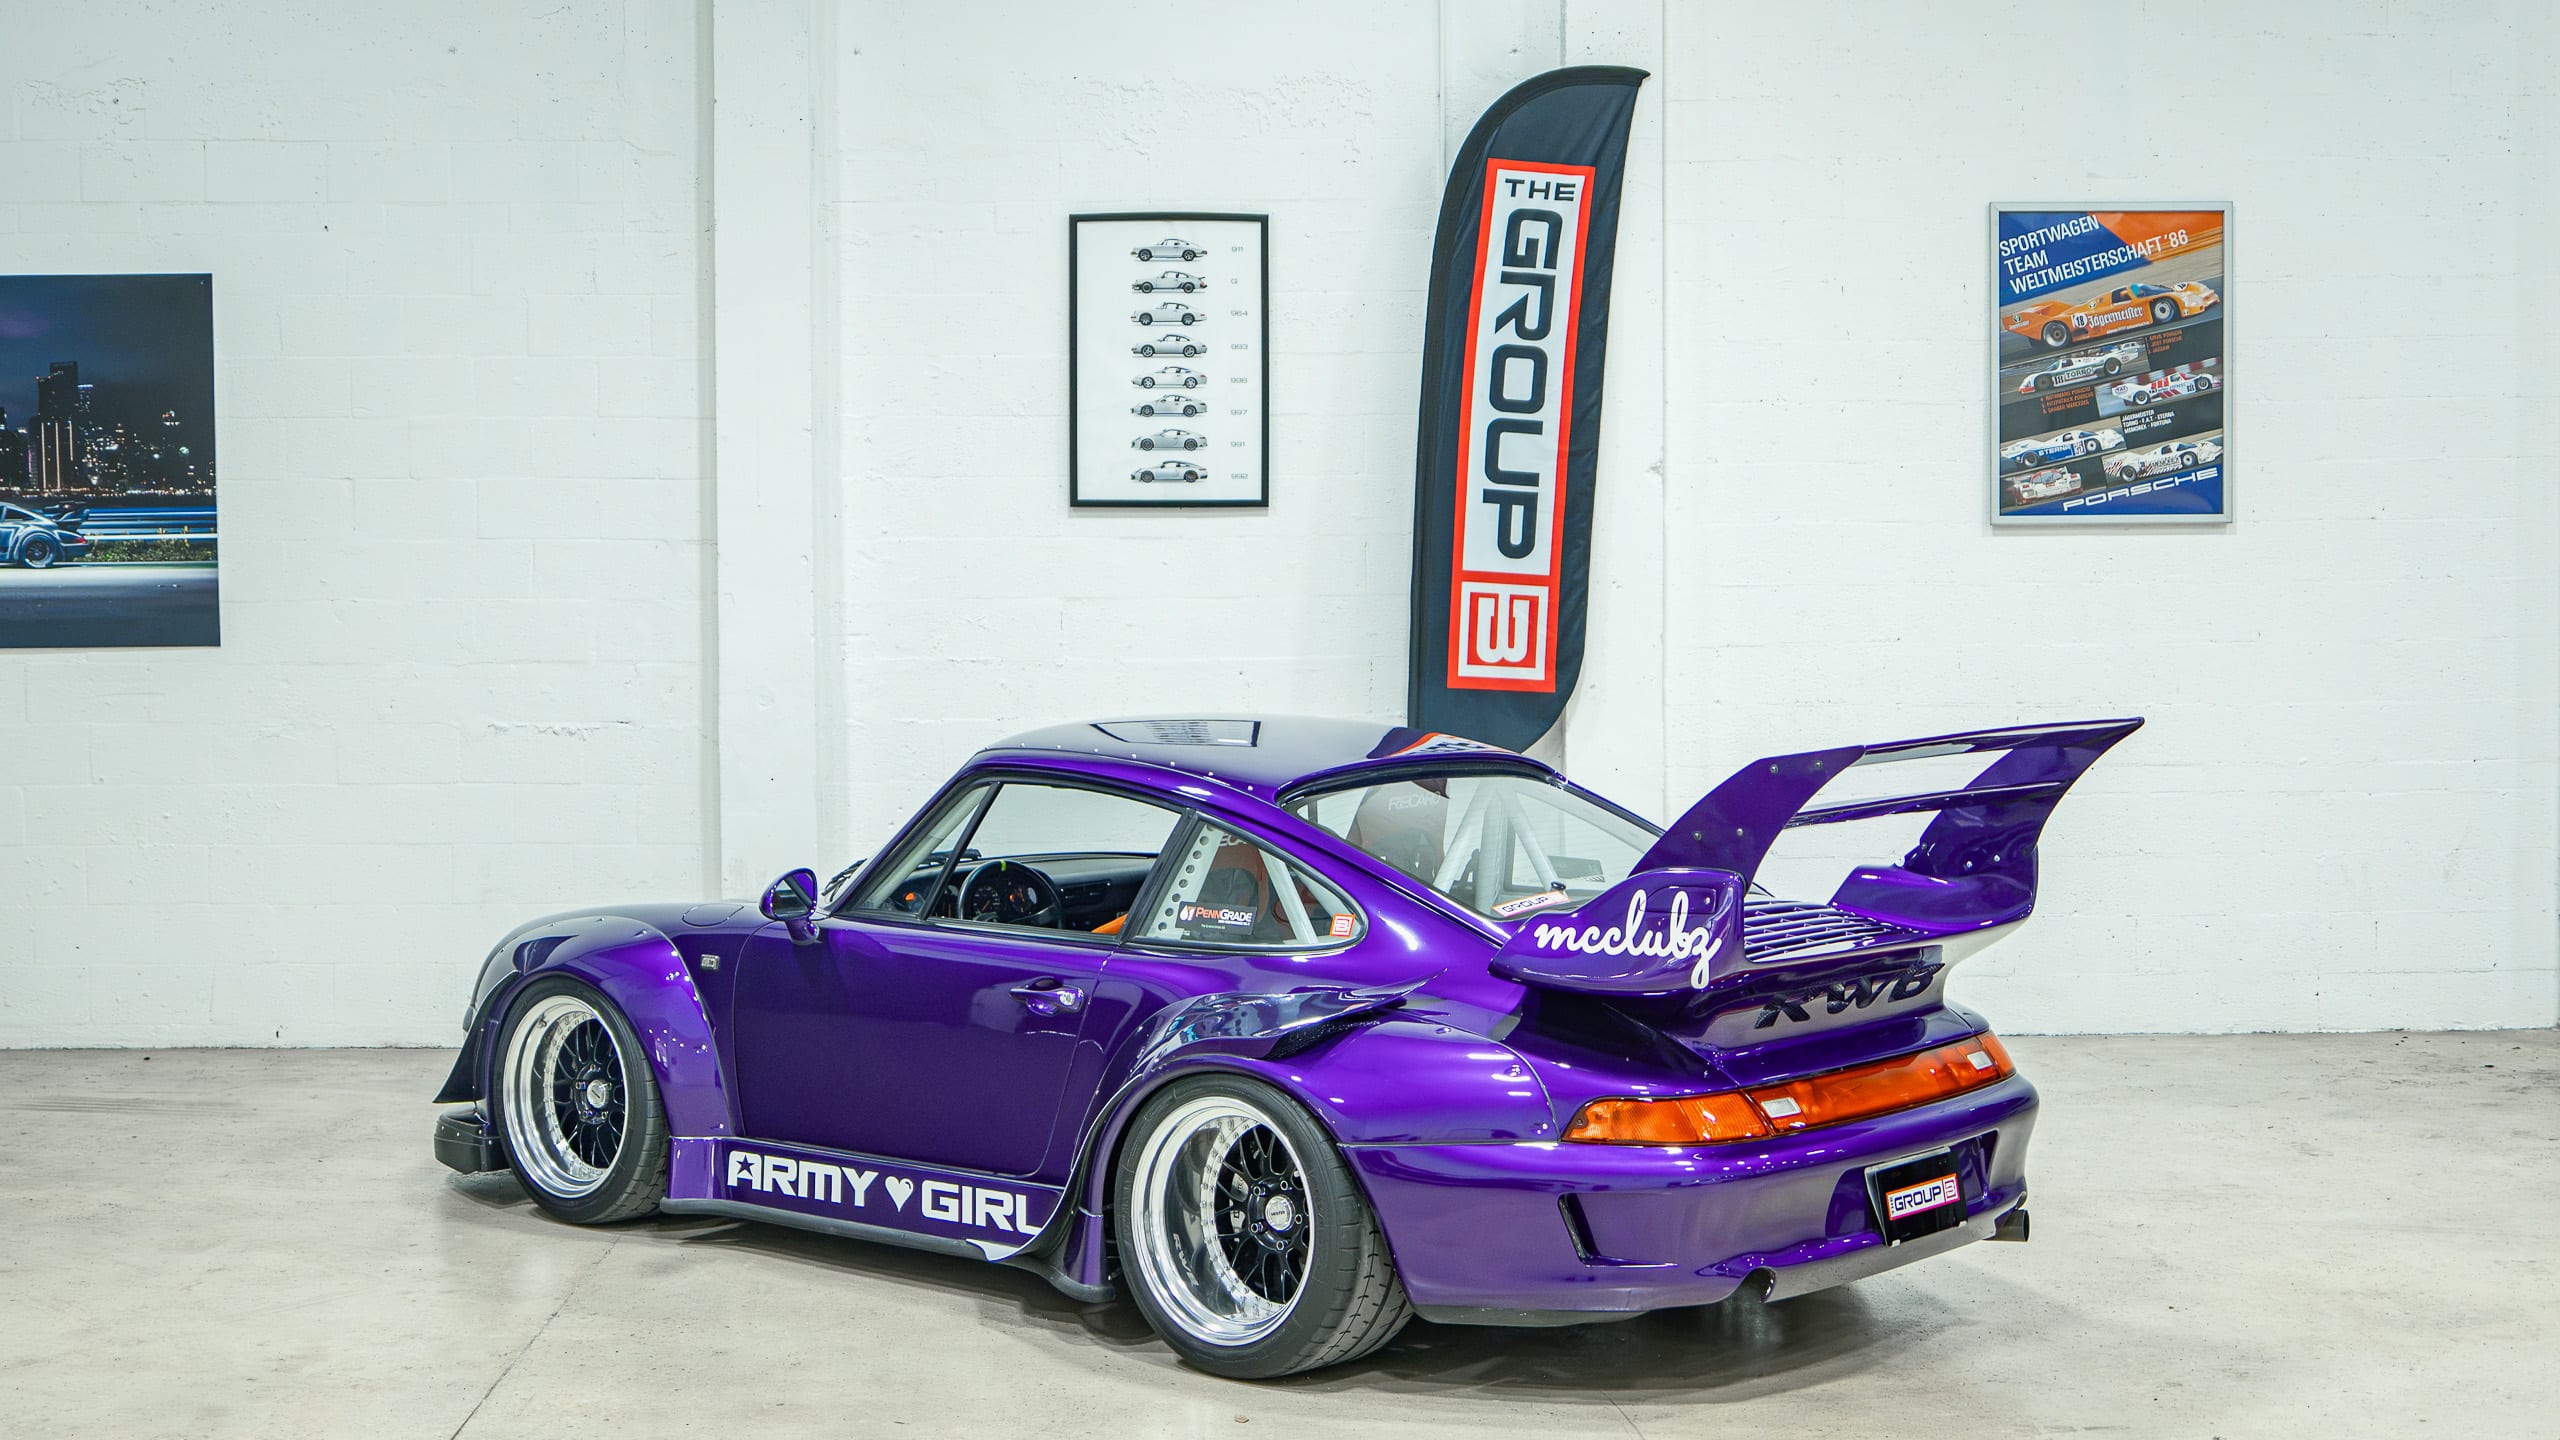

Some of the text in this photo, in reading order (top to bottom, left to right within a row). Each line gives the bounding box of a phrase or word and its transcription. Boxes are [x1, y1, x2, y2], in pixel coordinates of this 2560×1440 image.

[1504, 177, 1576, 202] THE
[2000, 214, 2100, 257] SPORTWAGEN
[2004, 249, 2049, 276] TEAM
[2010, 229, 2190, 294] WELTMEISTERSCHAFT '86
[1482, 208, 1564, 559] GROUP
[2063, 466, 2219, 512] PORSCHE
[1388, 790, 1441, 812] RECARO
[1534, 888, 1723, 990] mcclubz
[727, 1150, 1044, 1237] ARMY GIRL
[1894, 1185, 1942, 1212] GROUP
